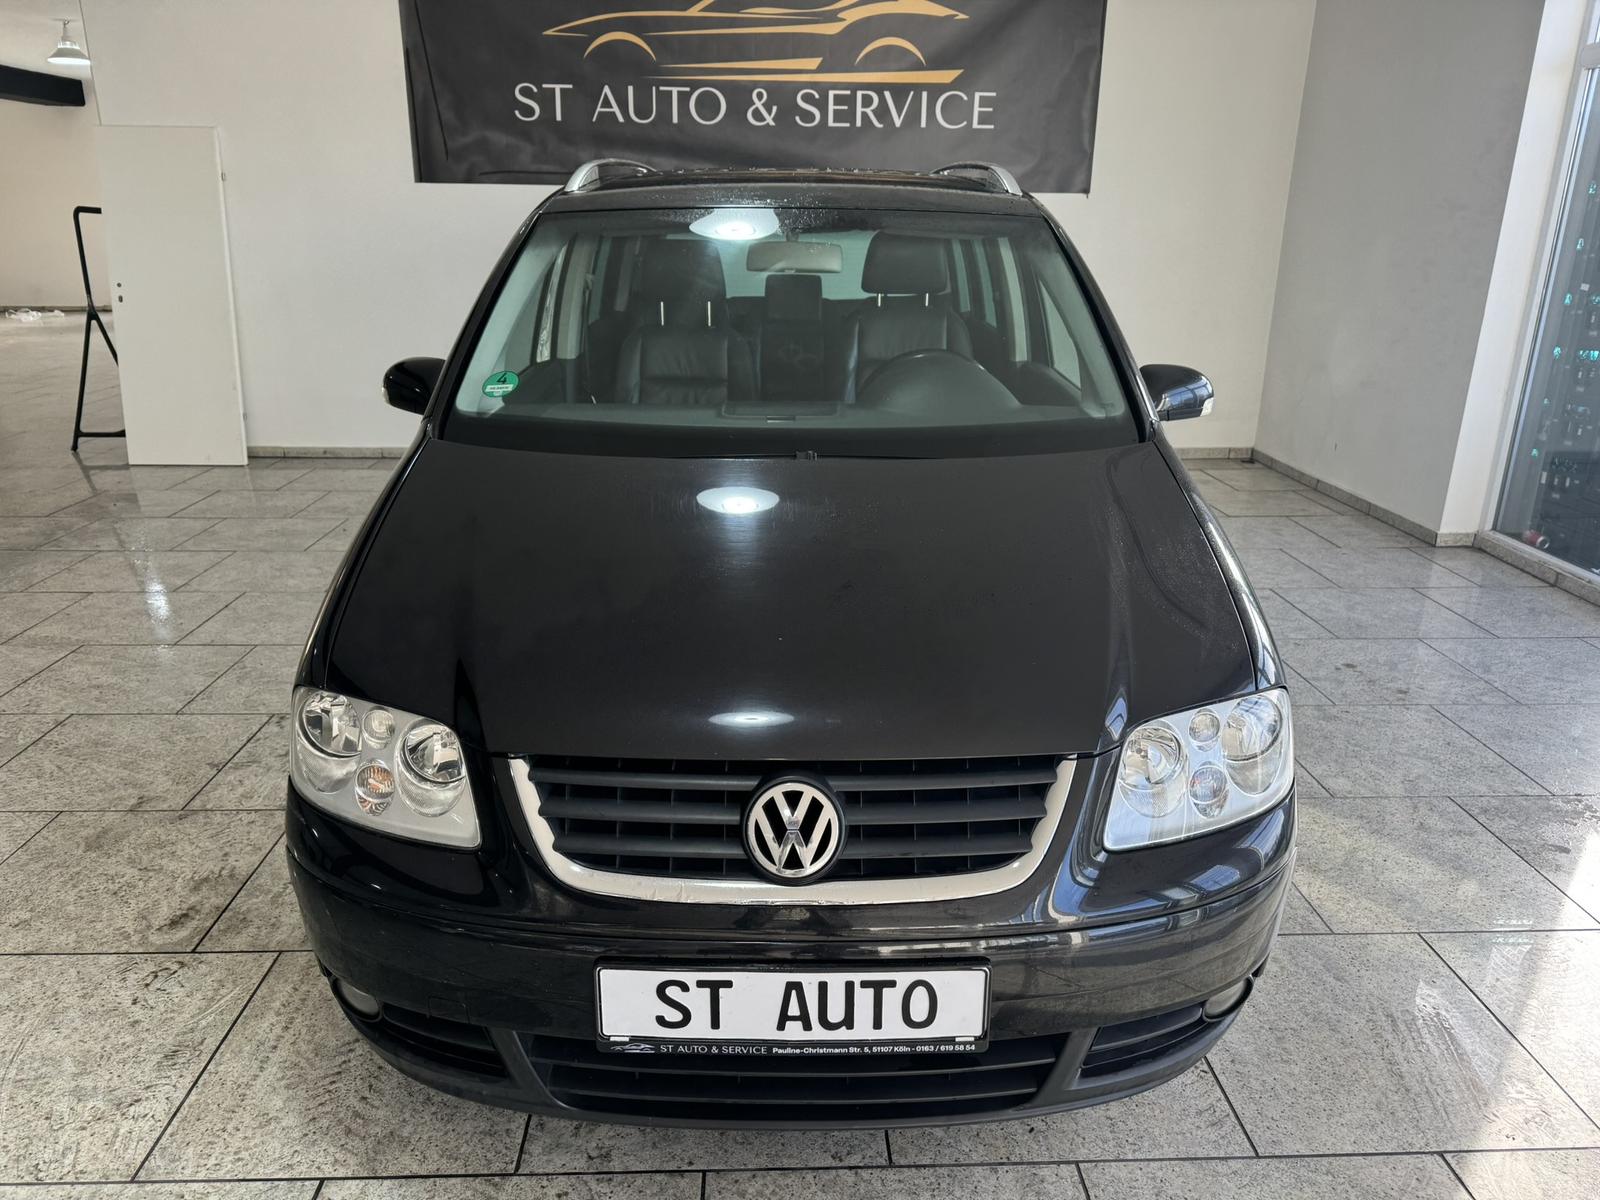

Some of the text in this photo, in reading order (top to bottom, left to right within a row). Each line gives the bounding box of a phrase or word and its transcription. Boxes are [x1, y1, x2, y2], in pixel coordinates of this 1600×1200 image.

[514, 82, 997, 130] ST AUTO & SERVICE
[496, 372, 508, 384] 4
[655, 979, 938, 1032] ST AUTO
[660, 1044, 768, 1055] ST AUTO & SERVICE
[772, 1046, 848, 1055] Pauline-Christmann
[849, 1046, 863, 1054] Str.
[864, 1046, 871, 1054] 5,
[872, 1045, 893, 1053] 51107
[894, 1044, 911, 1053] Köln
[916, 1044, 934, 1052] 0163
[940, 1044, 954, 1052] 619
[955, 1044, 965, 1052] 58
[965, 1043, 976, 1052] 54
